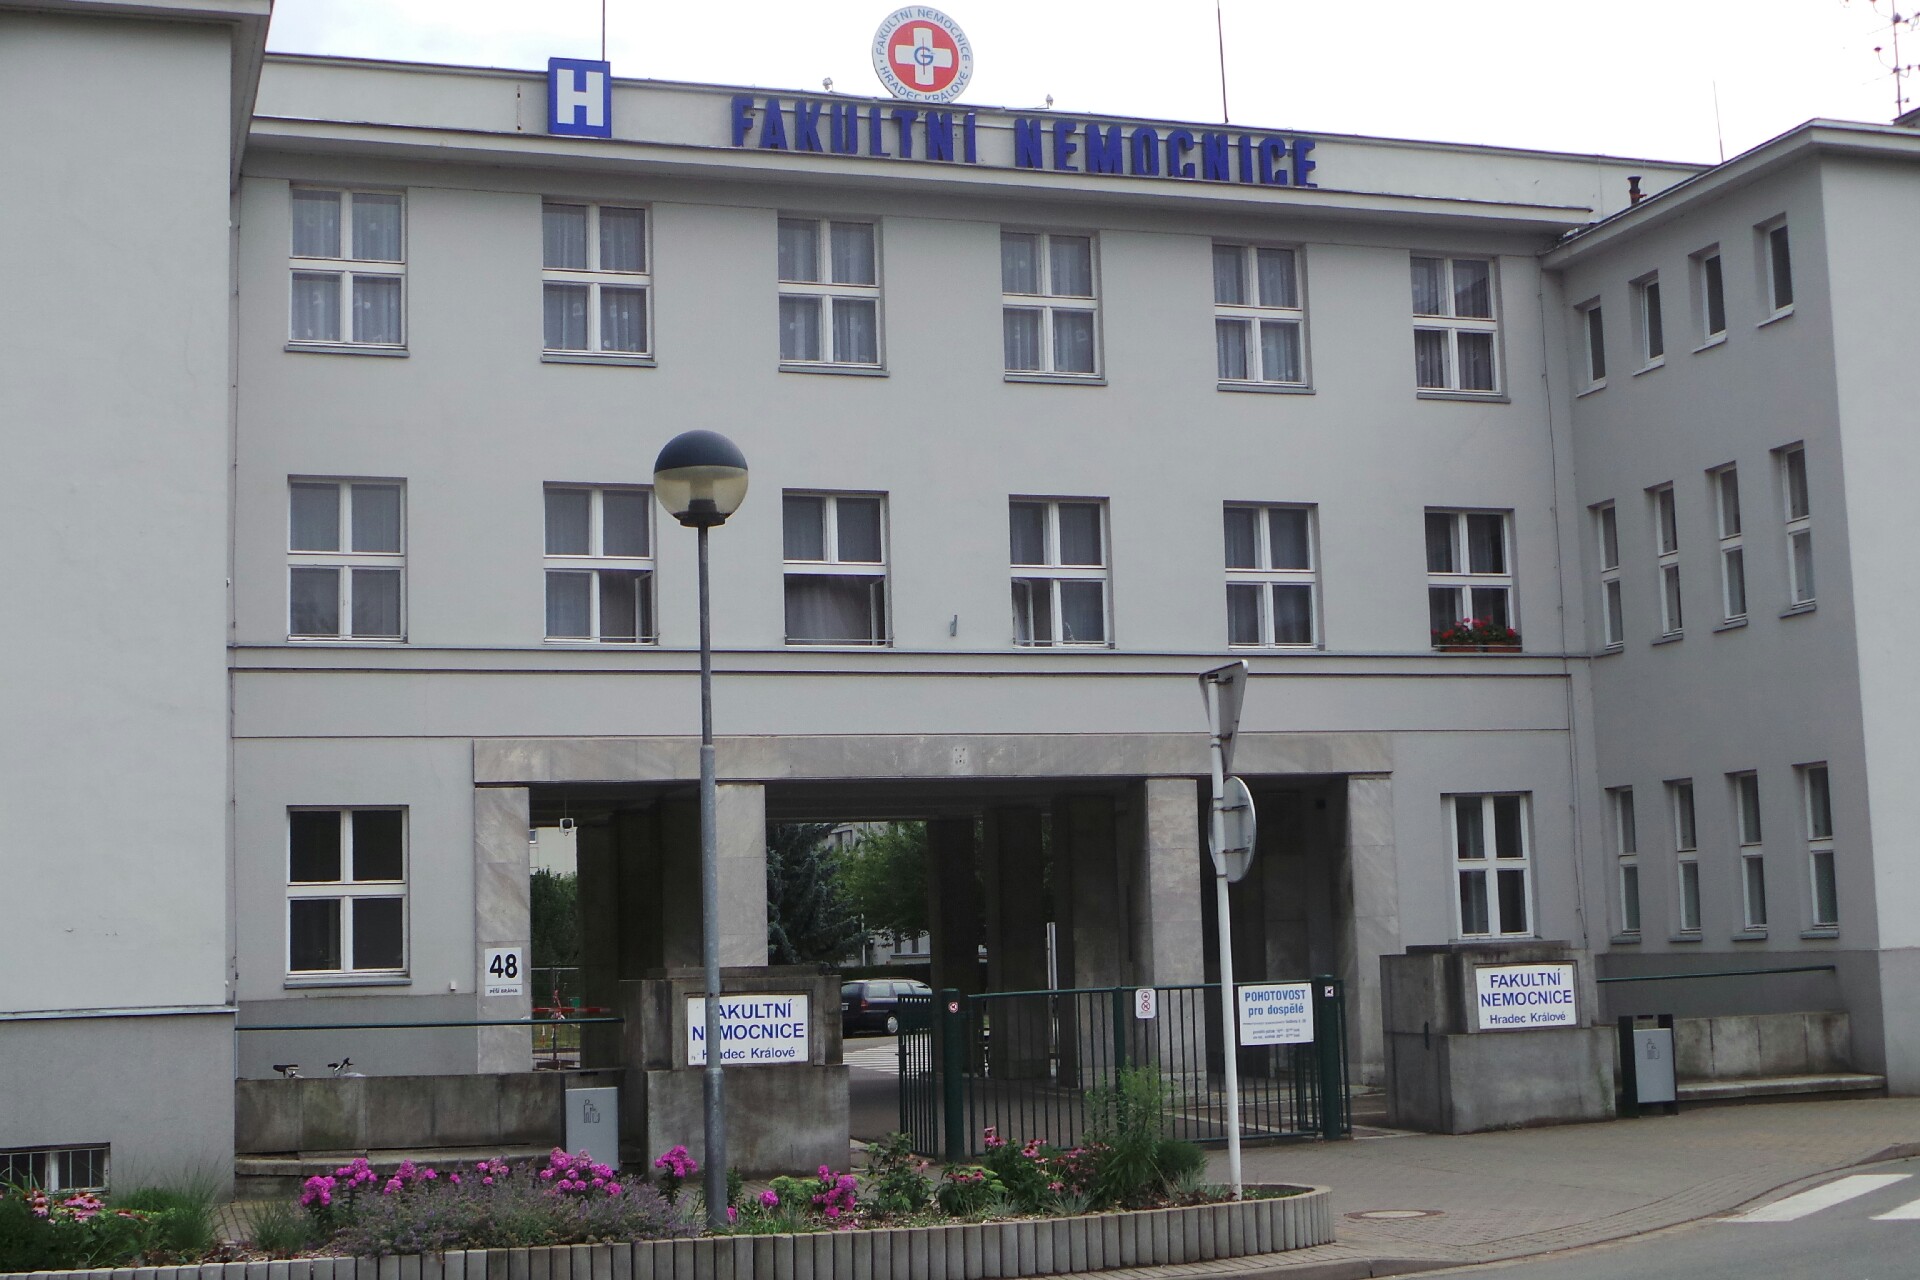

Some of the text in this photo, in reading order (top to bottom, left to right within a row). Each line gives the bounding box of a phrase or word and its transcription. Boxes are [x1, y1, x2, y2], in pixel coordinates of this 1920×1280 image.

[918, 9, 970, 61] NEMOCNICE
[556, 69, 604, 127] H
[1014, 118, 1317, 188] NEMOCNICE
[489, 953, 518, 979] 48
[1490, 968, 1561, 988] FAKULTNÍ
[1244, 989, 1306, 1002] POHOTOVOST
[1481, 989, 1573, 1007] NEMOCNICE
[719, 998, 792, 1019] AKULTNÍ
[1248, 1003, 1304, 1018] pro dospělé
[1489, 1010, 1566, 1024] Hradec Králové
[692, 1023, 805, 1041] NMOCNICE
[751, 1046, 796, 1059] Králové
